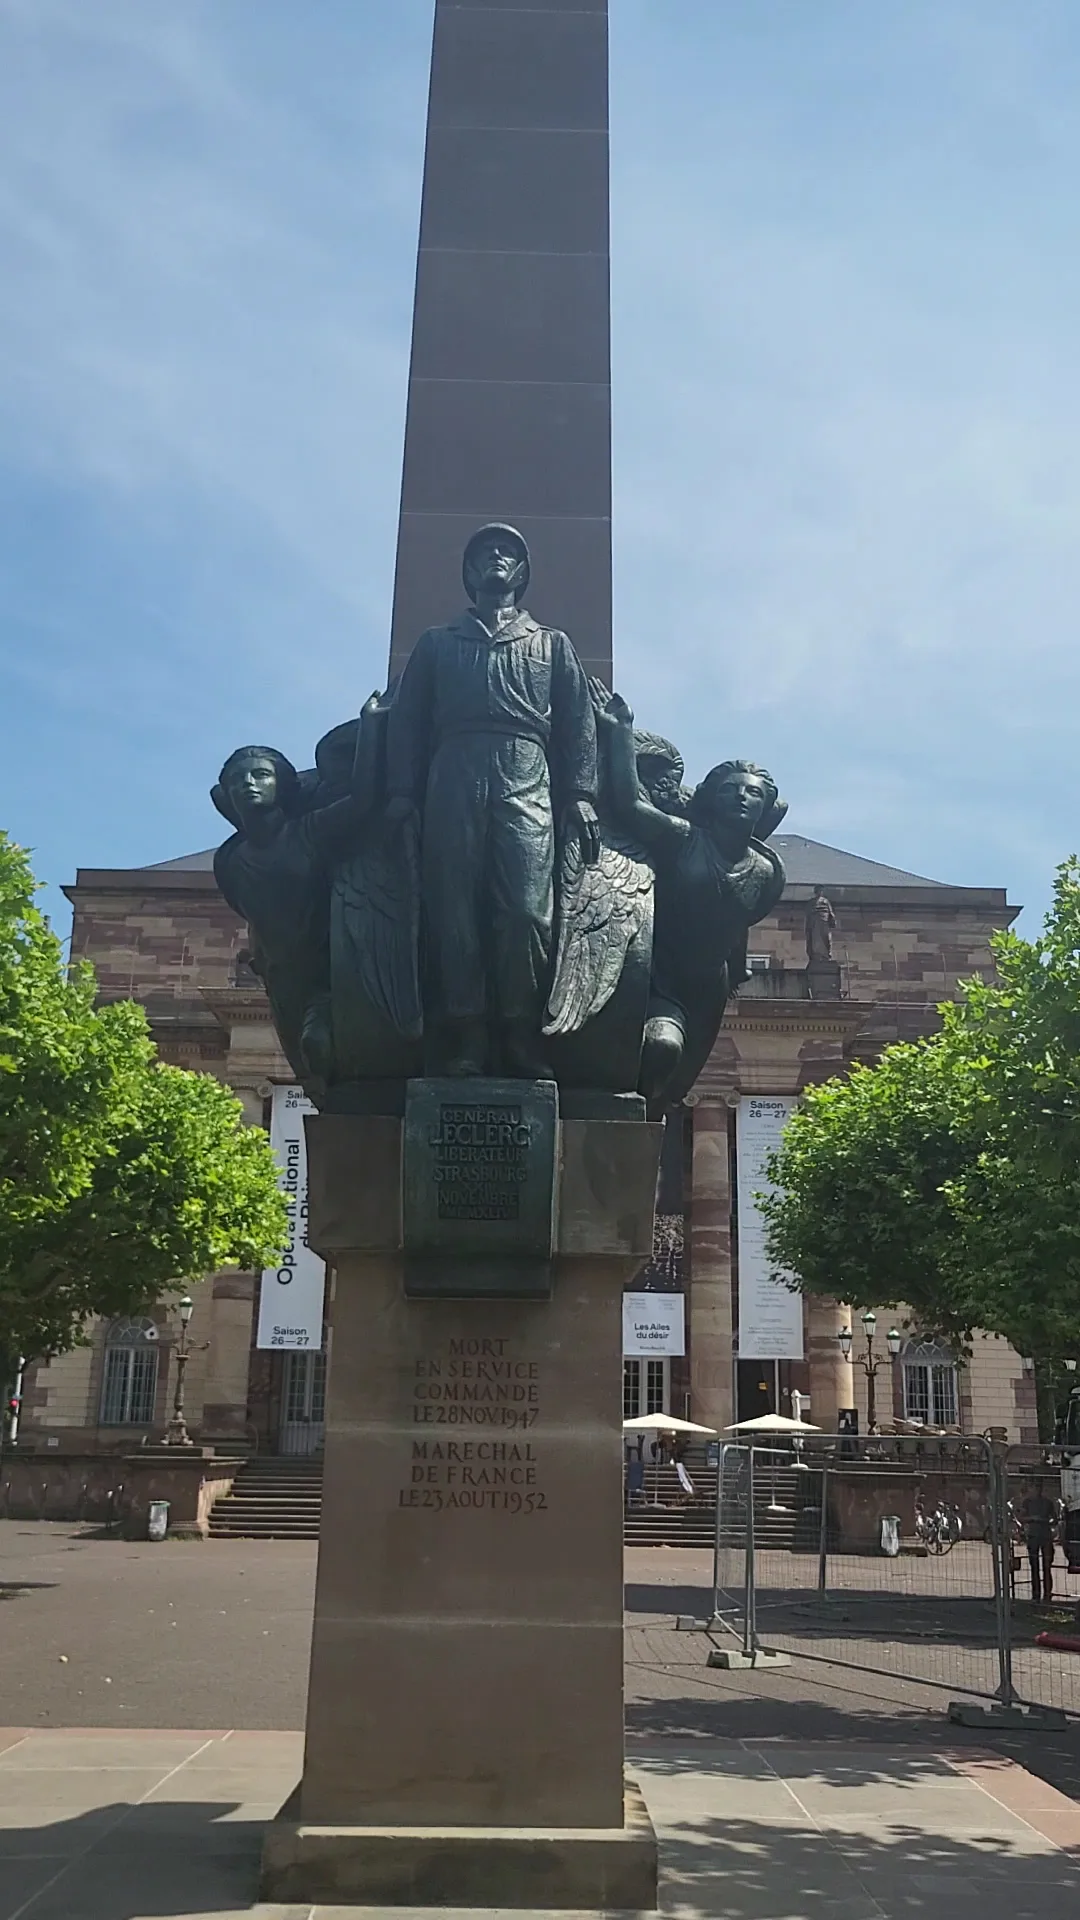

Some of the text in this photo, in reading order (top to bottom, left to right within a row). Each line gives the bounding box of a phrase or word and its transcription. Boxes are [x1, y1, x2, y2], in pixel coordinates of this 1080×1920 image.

[750, 1100, 784, 1109] Saison
[443, 1109, 520, 1124] GENERAL
[429, 1123, 532, 1147] LECLERC
[434, 1146, 526, 1162] LIBERATEUR
[433, 1164, 528, 1182] STRASBOURG
[438, 1189, 519, 1206] NOVEMBRE
[277, 1139, 299, 1285] Opa ntional
[273, 1325, 307, 1335] Saison
[634, 1323, 671, 1331] Les Ailes
[636, 1331, 669, 1339] du désir
[449, 1338, 510, 1358] MORT
[415, 1360, 540, 1381] EN SERVICE
[413, 1405, 434, 1423] LE
[436, 1405, 459, 1424] 28
[501, 1407, 540, 1429] 1947
[411, 1441, 537, 1463] MARECHAL
[411, 1465, 537, 1487] DE FRANCE
[398, 1489, 548, 1514] LE 23 AOUT 1952
